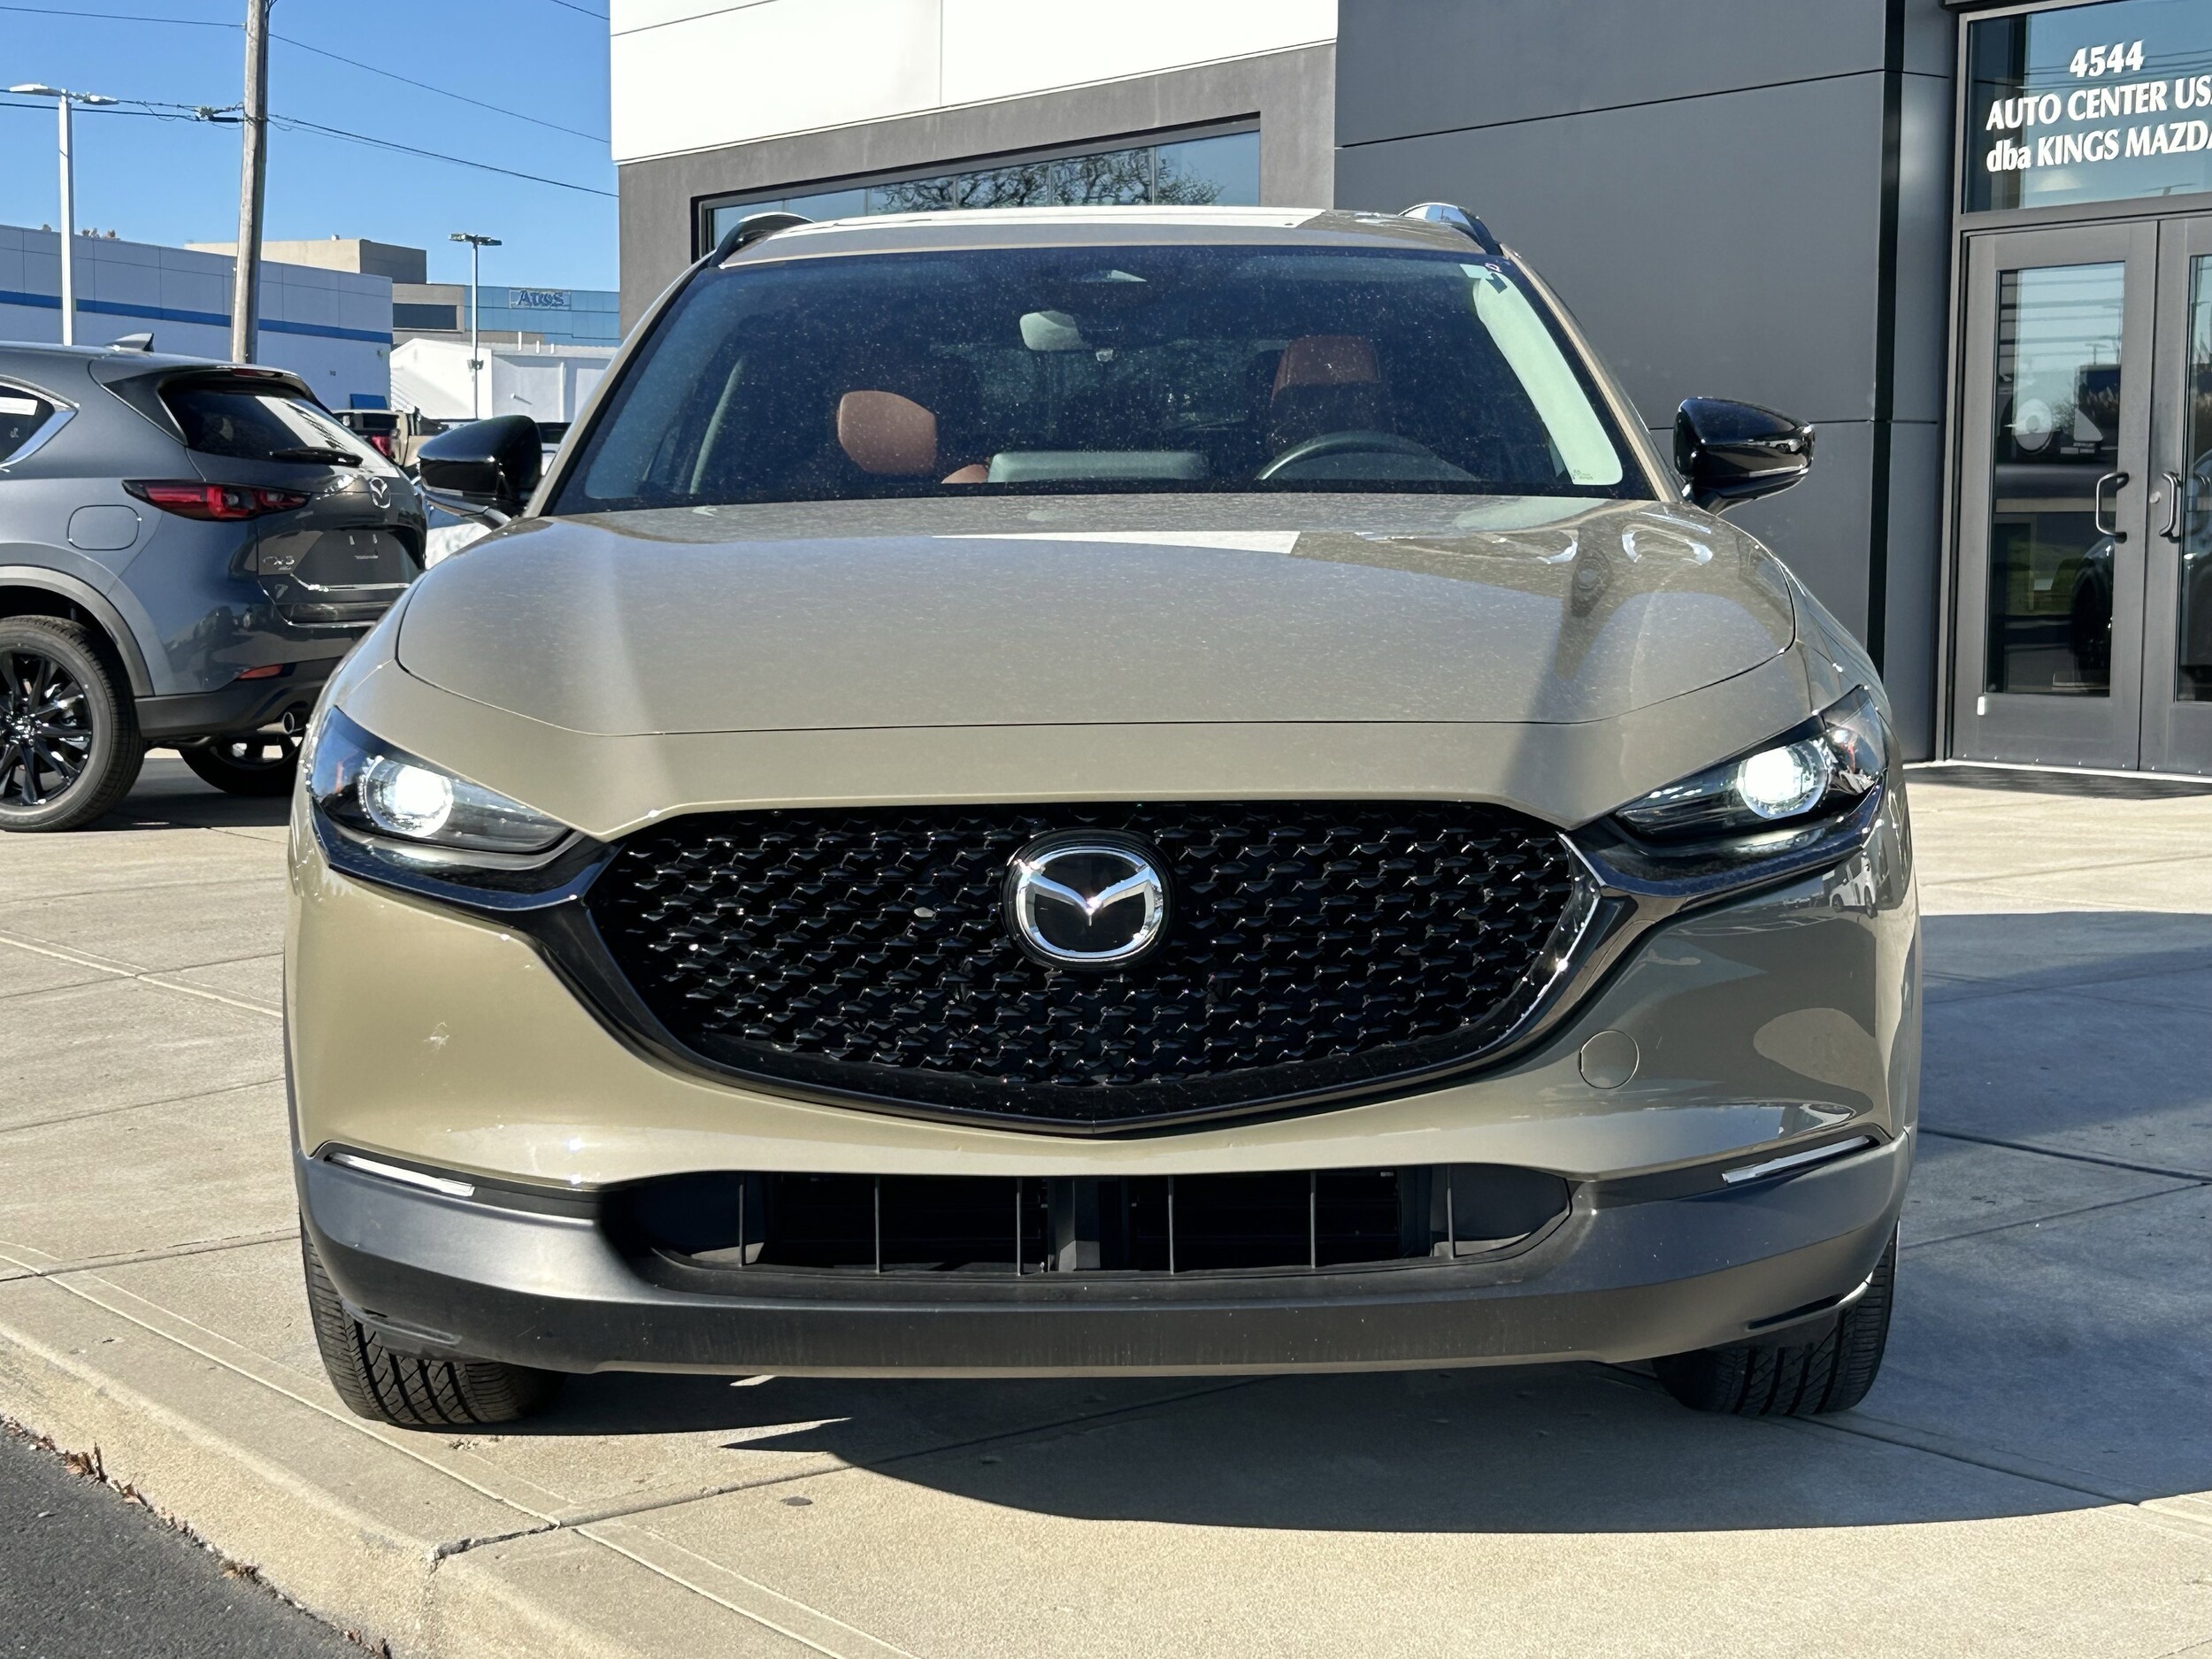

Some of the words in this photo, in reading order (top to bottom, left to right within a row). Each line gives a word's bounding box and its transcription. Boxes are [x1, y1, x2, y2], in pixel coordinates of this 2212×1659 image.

[2070, 40, 2144, 77] 4544
[1985, 93, 2062, 130] AUTO
[2067, 81, 2167, 121] CENTER
[2175, 74, 2212, 110] US
[1986, 139, 2032, 172] dba
[2037, 129, 2120, 166] KINGS
[2125, 120, 2212, 157] MAZD
